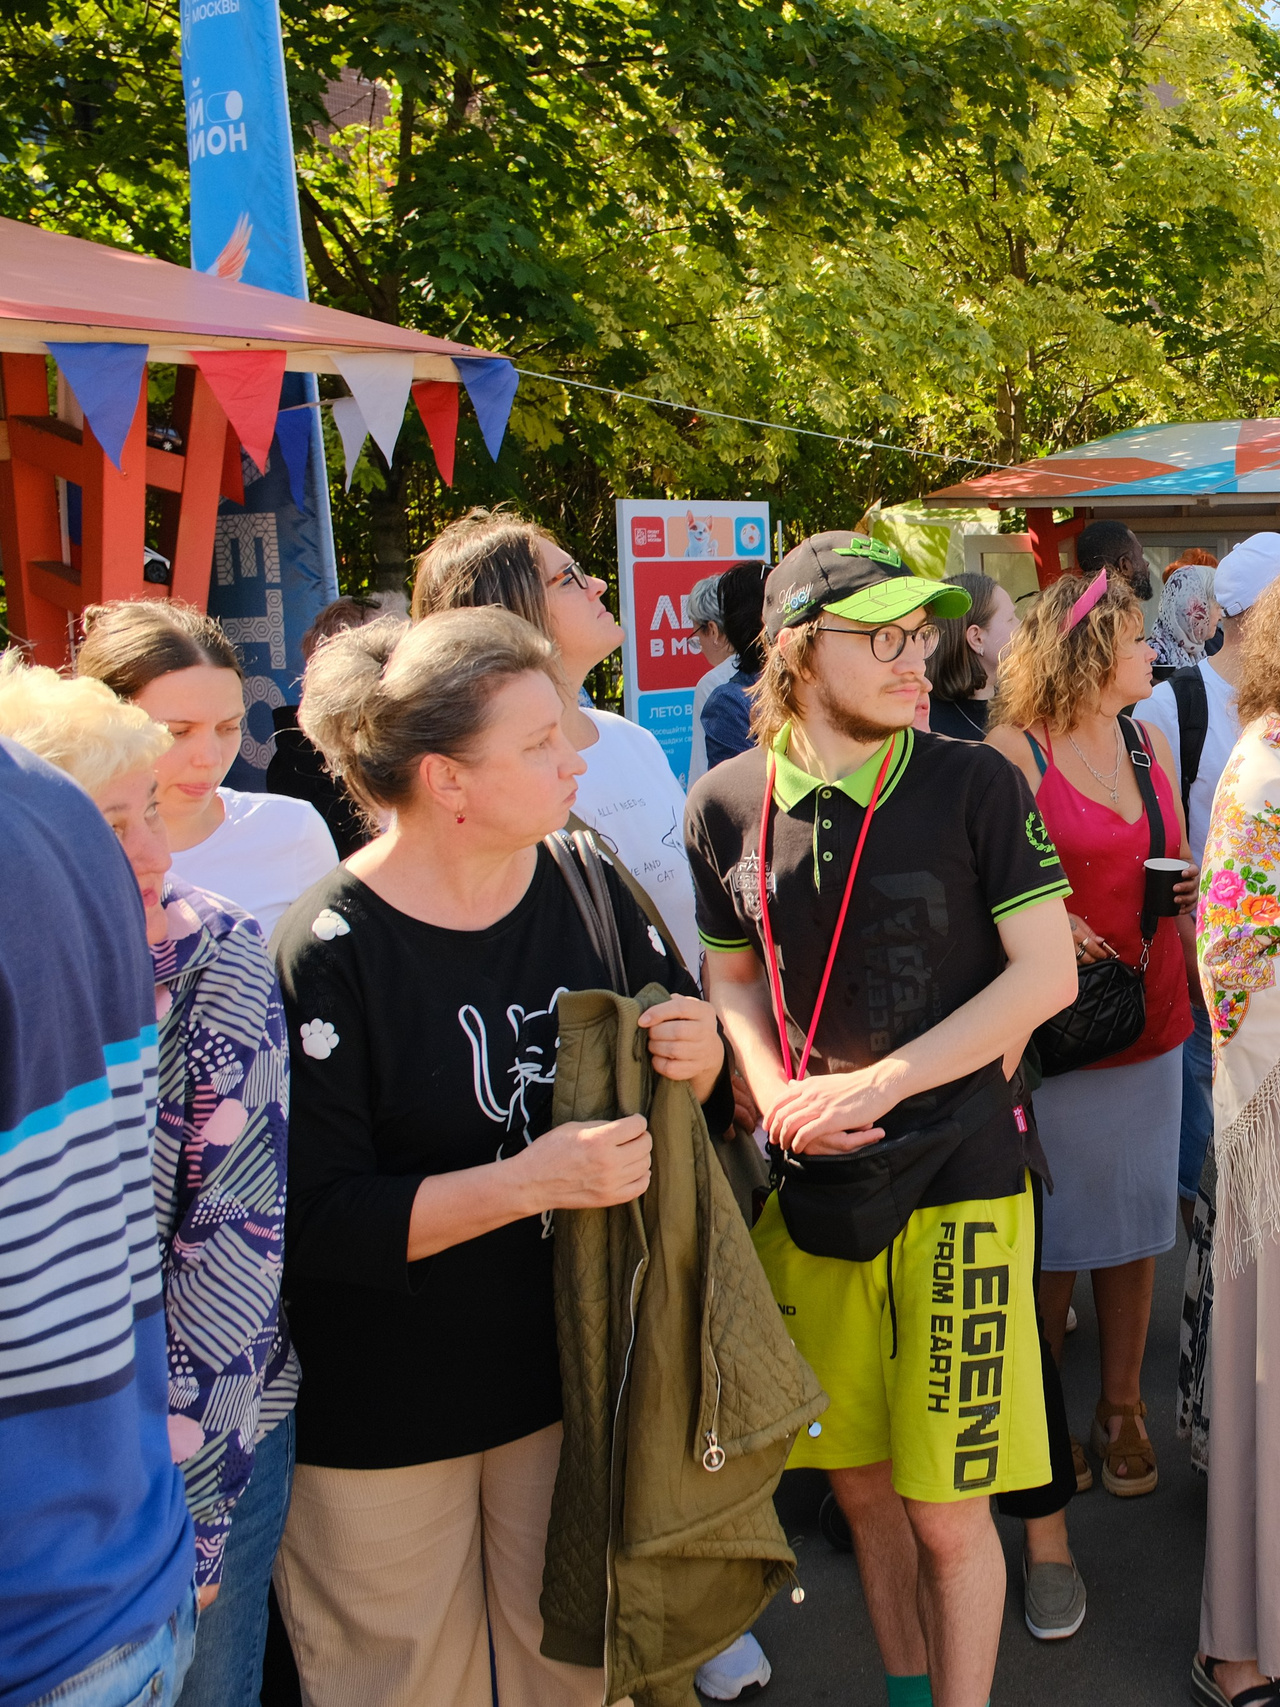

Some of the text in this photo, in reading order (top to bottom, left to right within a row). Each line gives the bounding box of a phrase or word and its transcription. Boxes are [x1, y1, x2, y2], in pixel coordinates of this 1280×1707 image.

[650, 636, 703, 657] В МО
[649, 705, 683, 719] ЛЕТО
[643, 859, 662, 874] AND
[657, 869, 675, 884] CAT
[931, 1221, 957, 1305] FROM
[777, 1302, 796, 1316] ND
[927, 1314, 954, 1414] EARTH
[953, 1221, 1010, 1492] LEGEND
